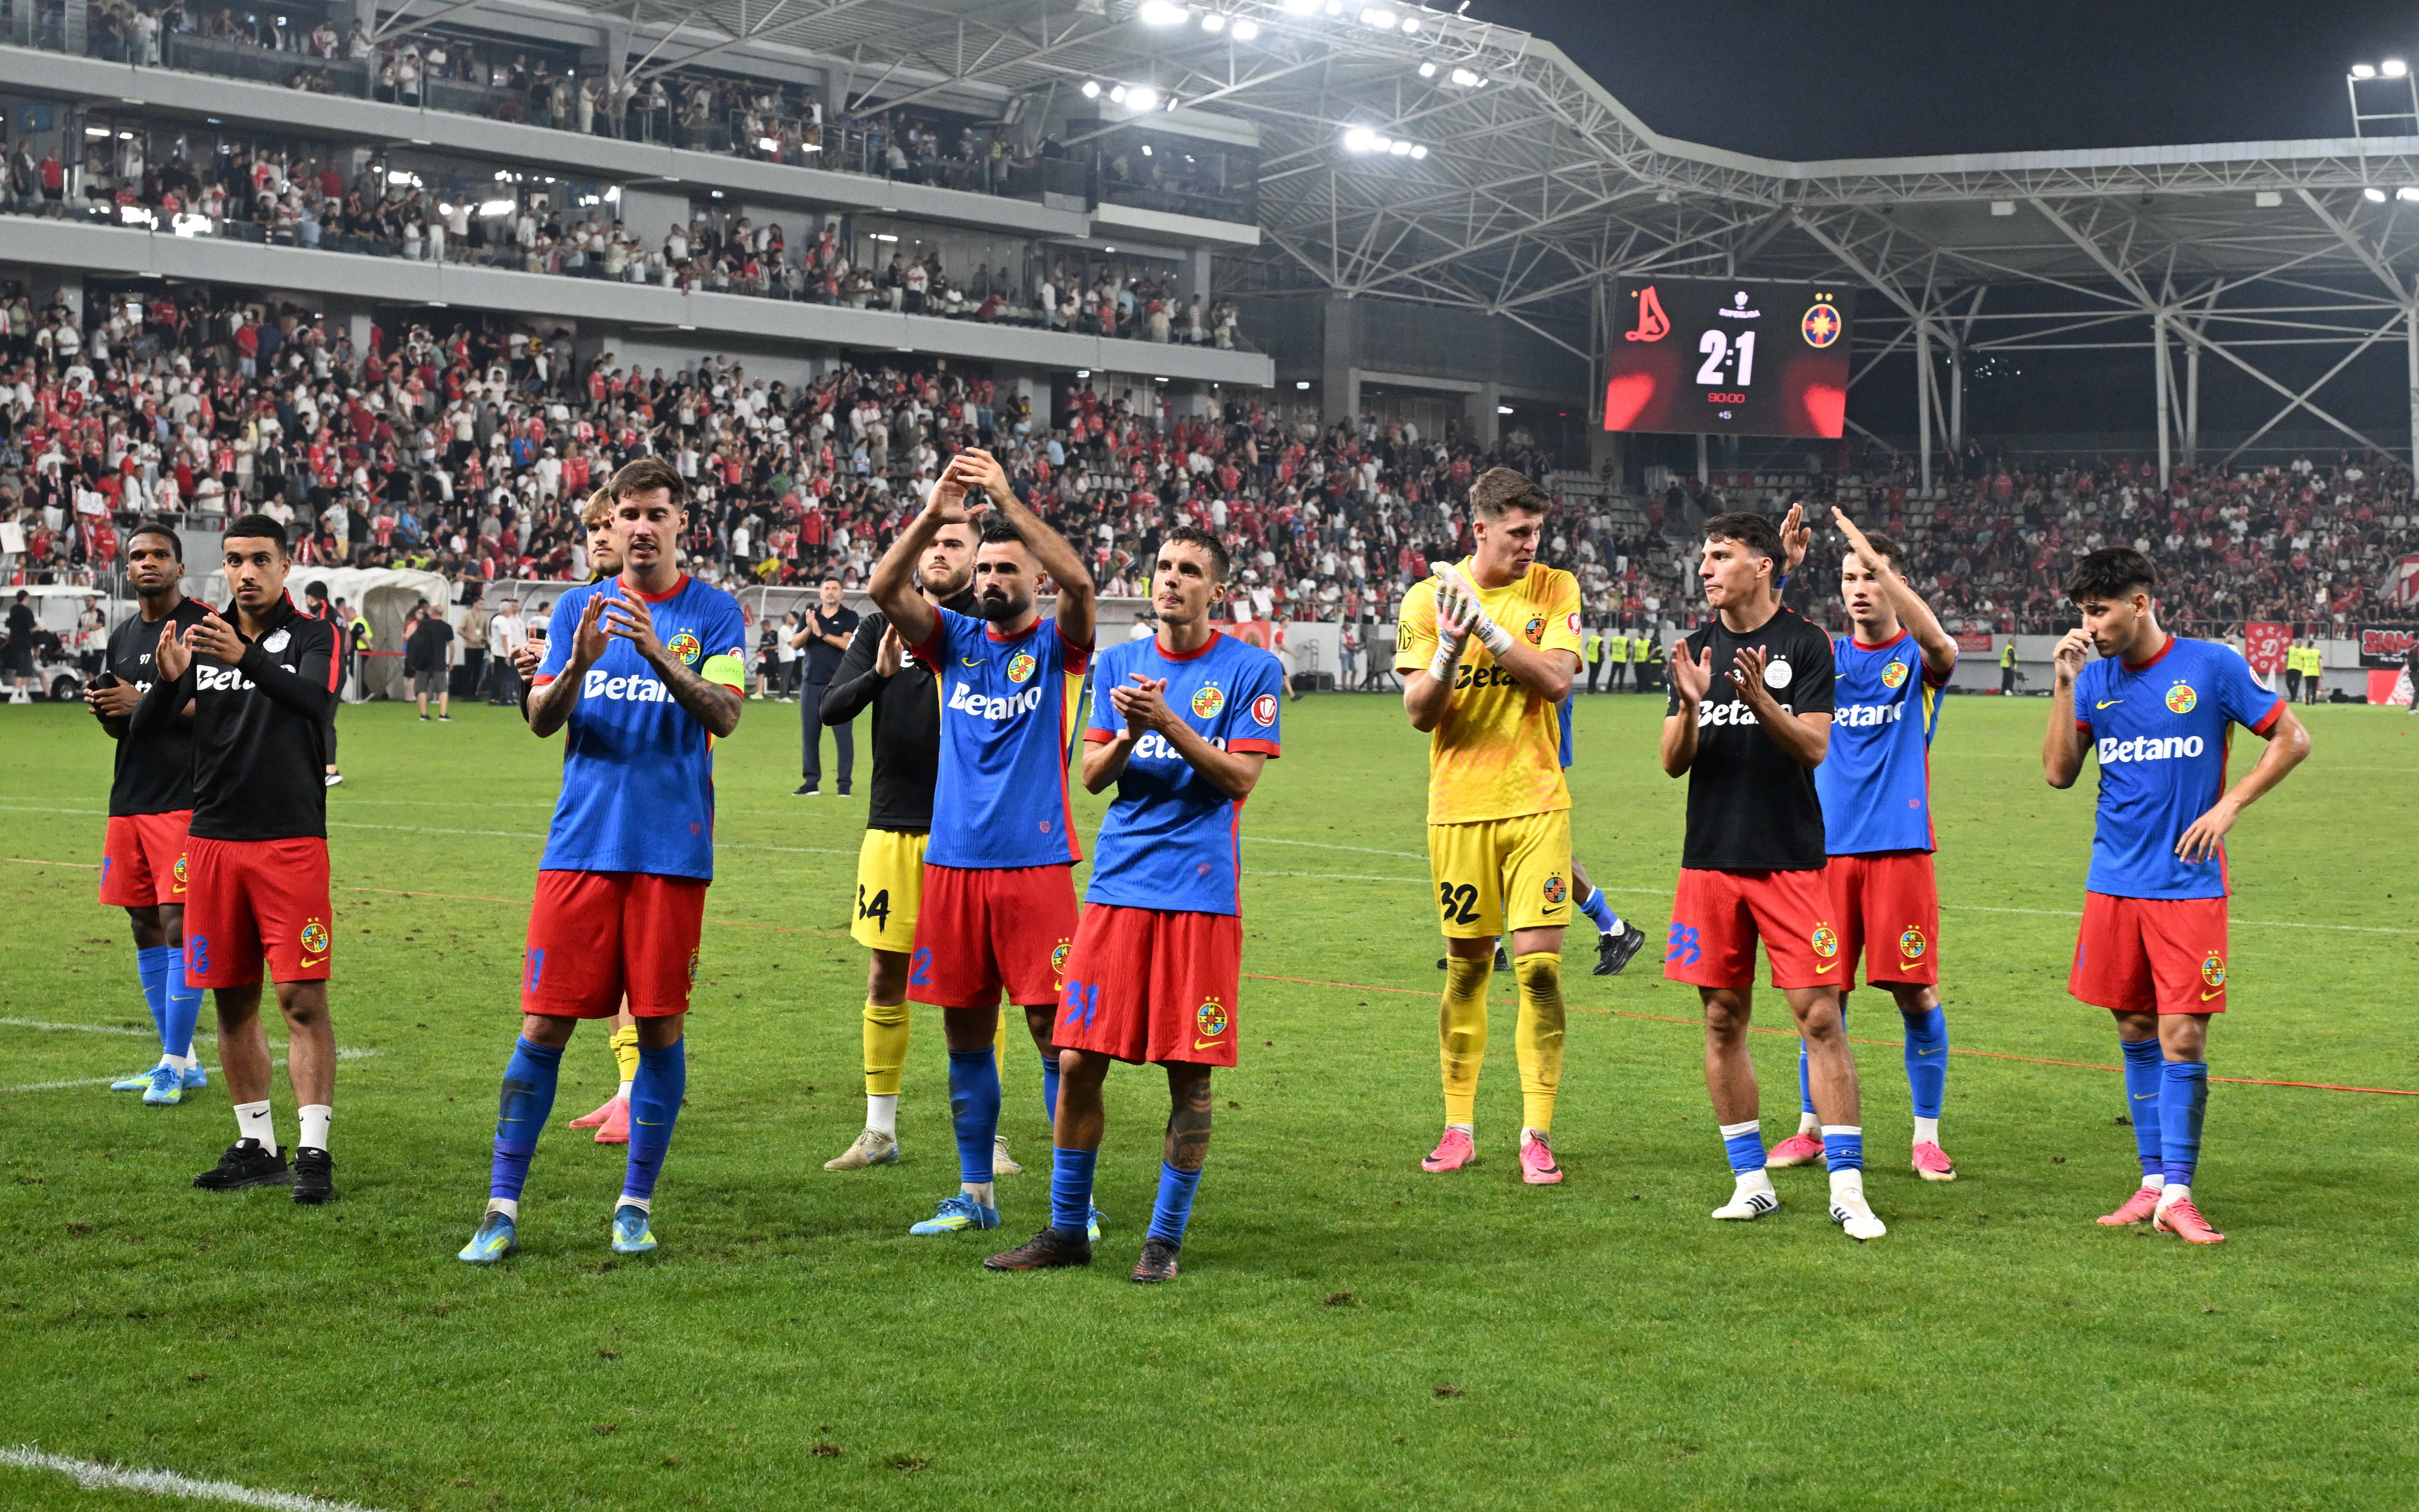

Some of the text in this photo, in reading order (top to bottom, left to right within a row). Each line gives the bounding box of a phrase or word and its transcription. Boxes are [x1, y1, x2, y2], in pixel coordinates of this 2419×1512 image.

[1696, 329, 1756, 386] 2:1
[140, 653, 151, 664] 97
[196, 664, 296, 691] Bet
[584, 670, 675, 703] Betan
[1455, 664, 1521, 690] Beta
[1733, 669, 1744, 681] 3
[1698, 699, 1793, 727] Beta
[1831, 701, 1905, 727] etano
[2099, 736, 2204, 764] Betano
[859, 884, 892, 935] 34
[1440, 881, 1482, 925] 32
[1666, 922, 1702, 967] 33
[909, 947, 932, 985] 2
[1063, 981, 1099, 1033] 31
